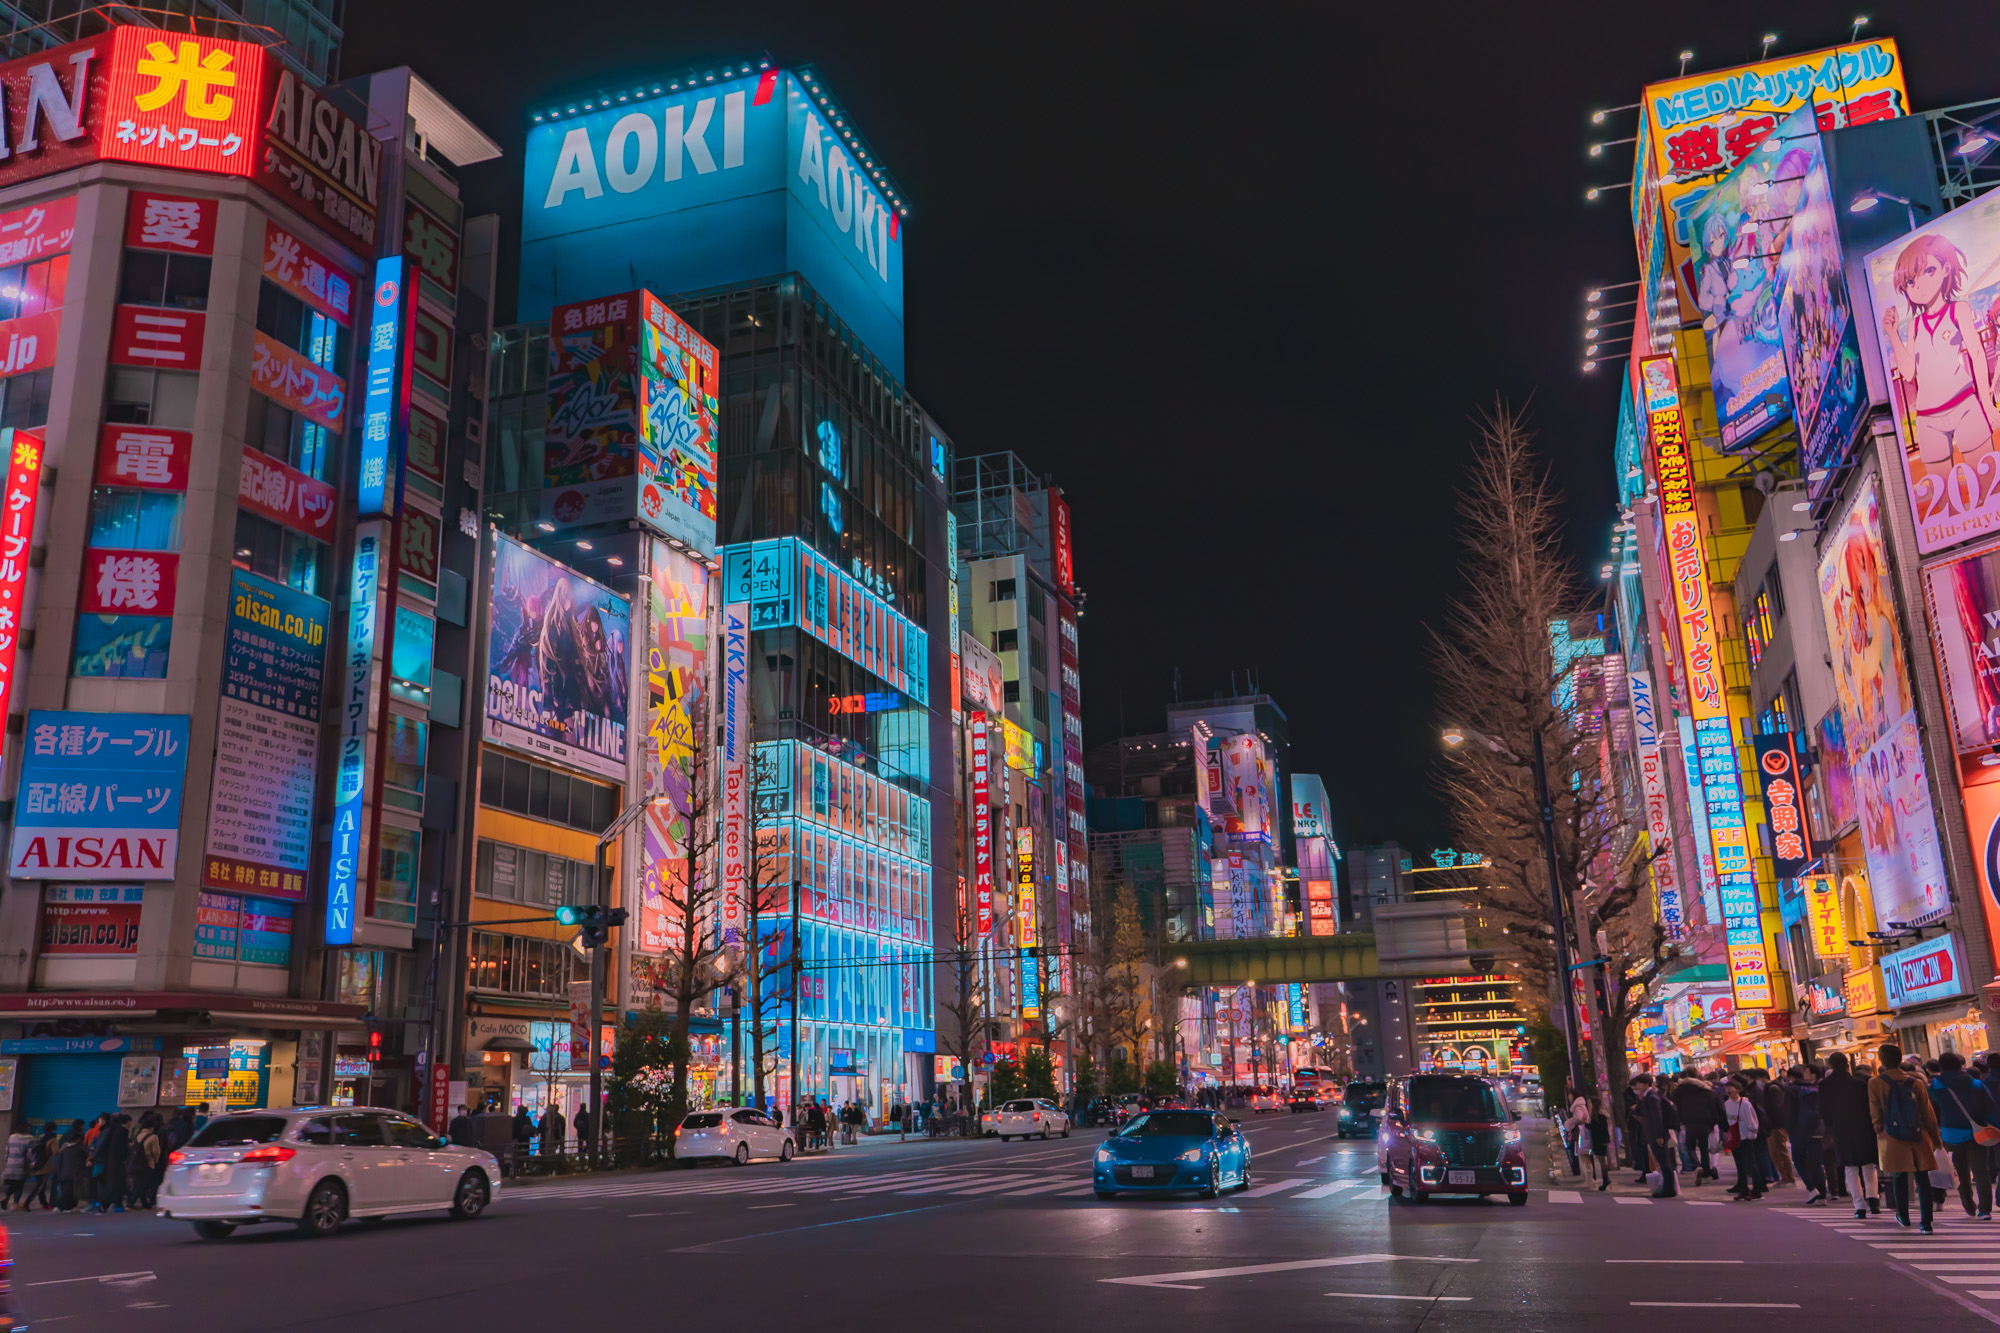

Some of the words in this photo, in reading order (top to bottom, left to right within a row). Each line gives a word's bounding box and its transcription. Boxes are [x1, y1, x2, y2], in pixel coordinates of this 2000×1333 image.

[135, 41, 235, 121] 光
[116, 119, 242, 156] ネットワーク
[267, 70, 382, 206] AISAN
[544, 90, 746, 208] AOKI
[799, 110, 889, 283] AOKI
[564, 300, 628, 331] 免税店
[252, 343, 344, 420] ネットワーク
[363, 321, 395, 489] 愛三電機
[1653, 411, 1679, 423] DVD
[651, 392, 698, 449] AKKY
[1656, 433, 1682, 446] ゲーム
[1661, 445, 1679, 456] CD
[1659, 456, 1685, 468] アイドル
[1660, 467, 1687, 480] アニメ
[239, 458, 334, 528] 配線パーツ
[1663, 479, 1688, 490] コミック
[1665, 490, 1690, 502] ホビー
[742, 556, 779, 579] 24h
[853, 556, 896, 601] ホルモン
[741, 580, 779, 594] OPEN
[235, 594, 324, 647] aisan.co.jp
[728, 614, 744, 684] AKKY
[727, 667, 737, 762] INTERNATIONAL
[1631, 677, 1654, 733] AKKY
[33, 724, 178, 757] 各種ケーブル
[1702, 735, 1728, 745] DVD
[1705, 761, 1732, 772] DVD
[1705, 775, 1716, 785] 4F
[27, 783, 172, 815] 配線パーツ
[1708, 803, 1721, 813] 3F
[1709, 790, 1737, 801] DVD
[726, 765, 743, 858] Tax-free
[1641, 752, 1665, 834] Tax-free
[1655, 836, 1674, 887] Shop
[17, 837, 167, 869] AISAN
[1718, 846, 1745, 859] 買取
[1720, 859, 1747, 870] フロア
[210, 862, 230, 881] 各社
[236, 865, 255, 885] 特約
[260, 869, 279, 889] 在庫
[331, 810, 354, 930] AISAN
[1720, 874, 1731, 885] 1F
[726, 863, 742, 919] Shop
[1022, 899, 1035, 944] DVD
[1725, 902, 1754, 914] DVD
[645, 931, 676, 948] Tax-free
[1734, 961, 1763, 972] ムーラン
[1736, 974, 1766, 986] AKIBA
[1903, 960, 1929, 989] COMIC
[1927, 956, 1943, 983] ZIN
[27, 998, 136, 1008] http://www.aisan.co.jp
[480, 1024, 497, 1034] Cafe
[498, 1025, 528, 1035] MOCO
[65, 1040, 93, 1051] 1949
